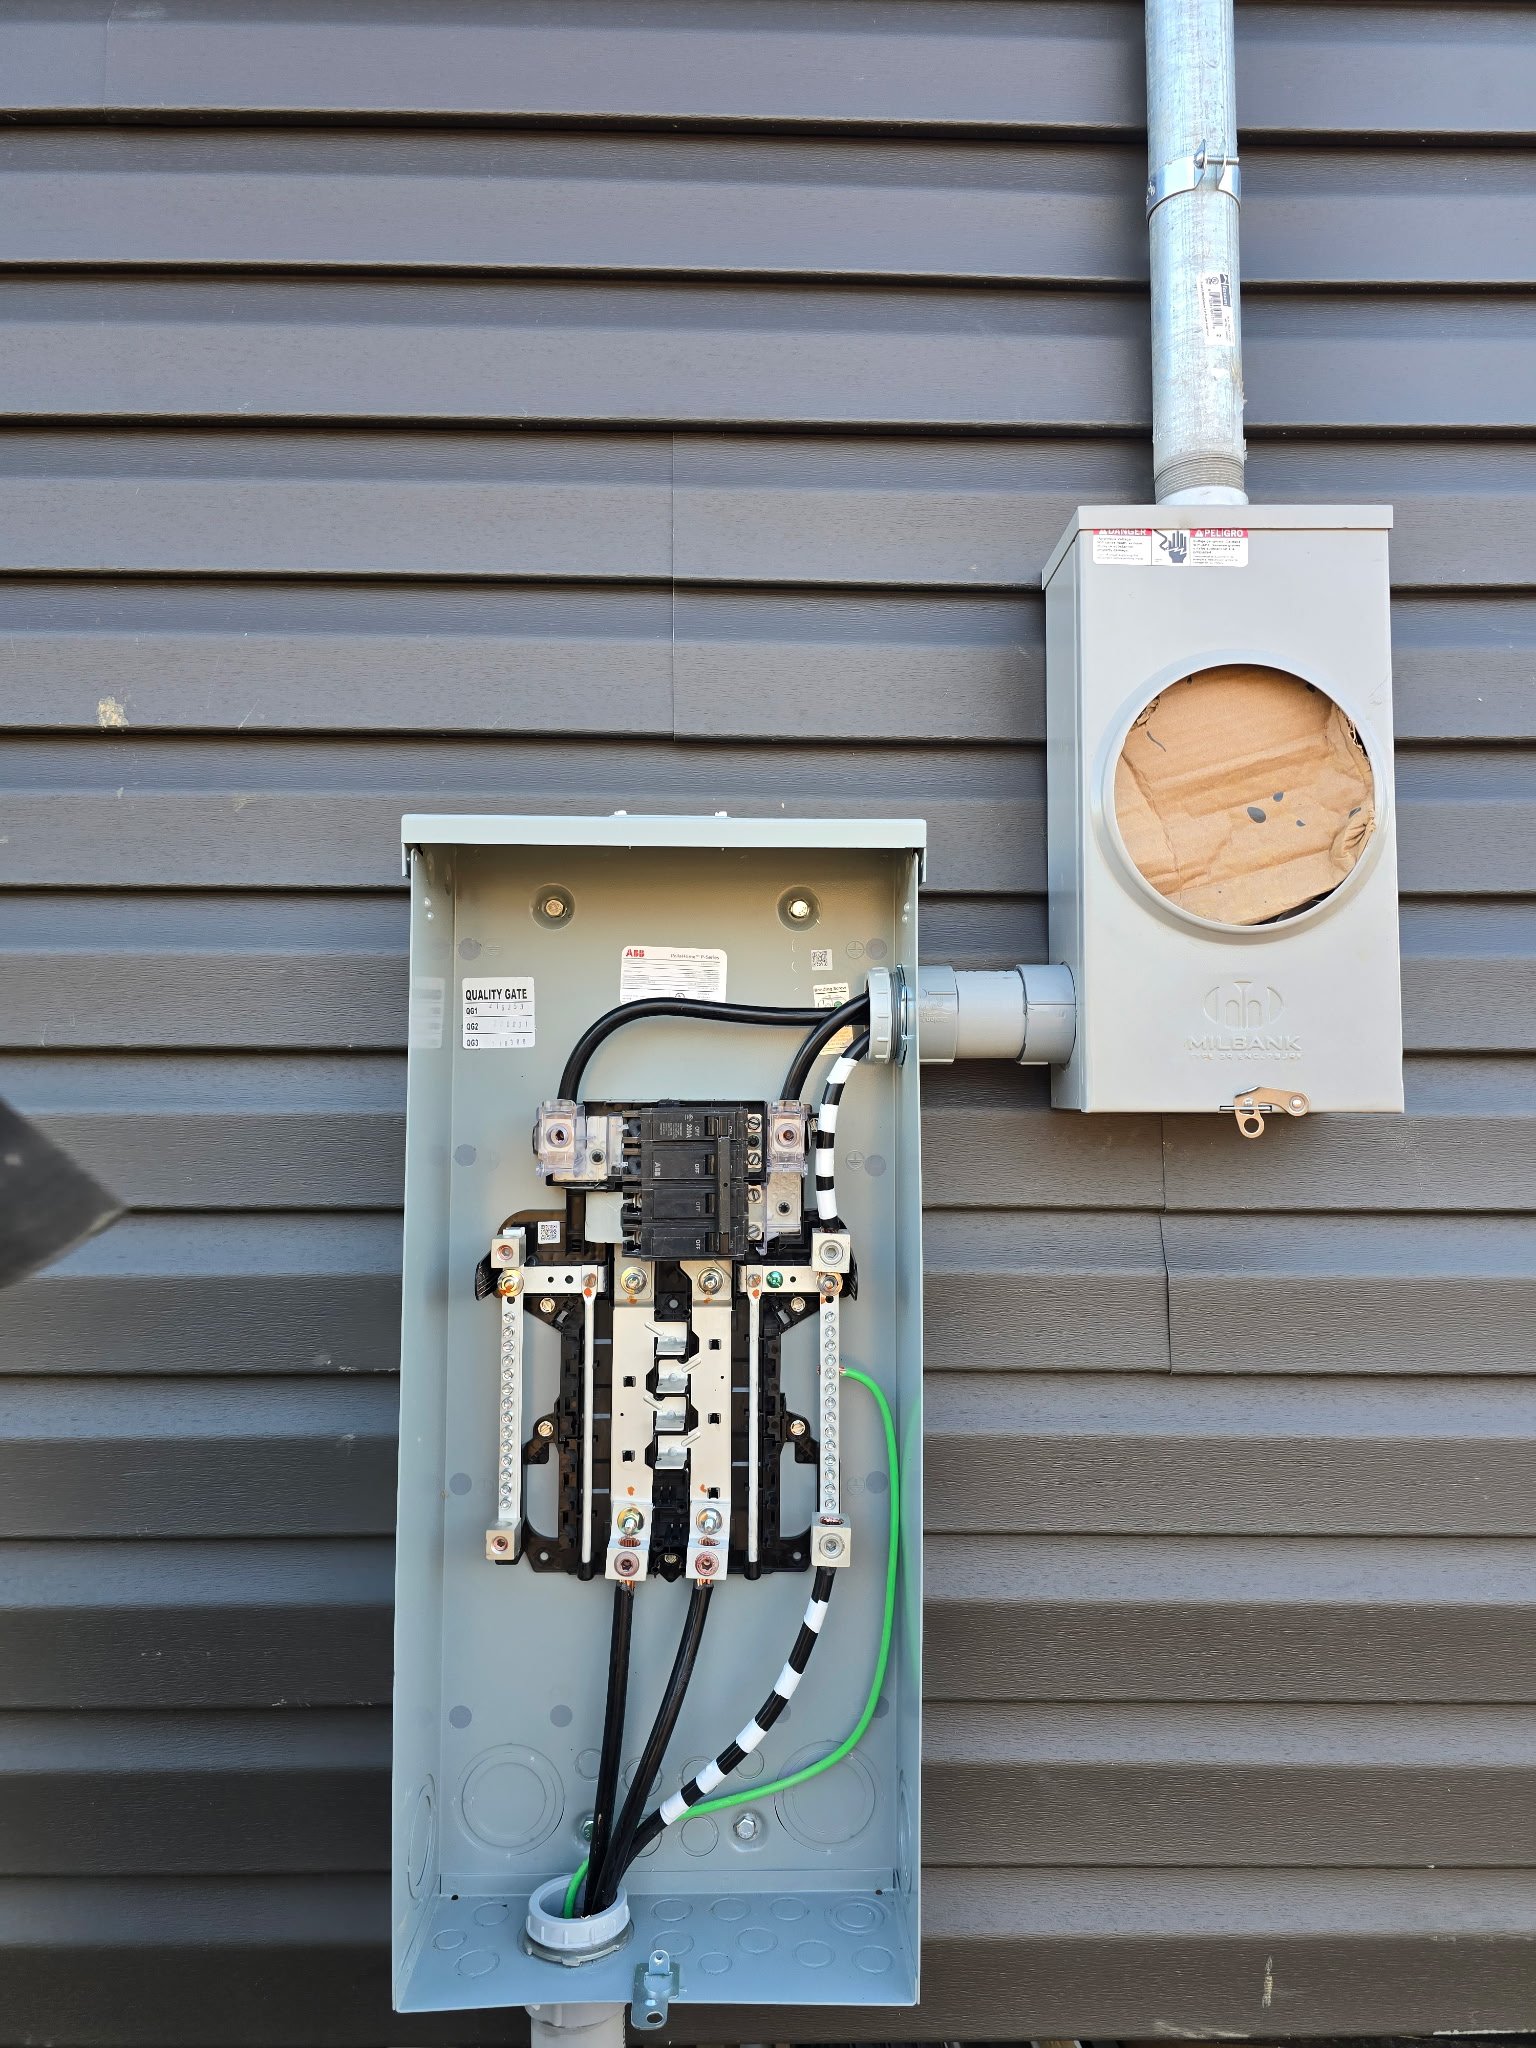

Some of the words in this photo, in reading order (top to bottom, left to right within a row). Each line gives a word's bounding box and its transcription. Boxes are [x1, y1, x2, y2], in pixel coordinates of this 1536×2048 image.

[1204, 529, 1243, 537] PELIGRO
[625, 948, 645, 958] ABB
[465, 989, 503, 1001] QUALITY
[504, 988, 528, 1000] GATE
[465, 1007, 478, 1015] QG1
[466, 1022, 479, 1031] QG2
[466, 1039, 479, 1047] QG3
[1187, 1035, 1303, 1052] MILBANK
